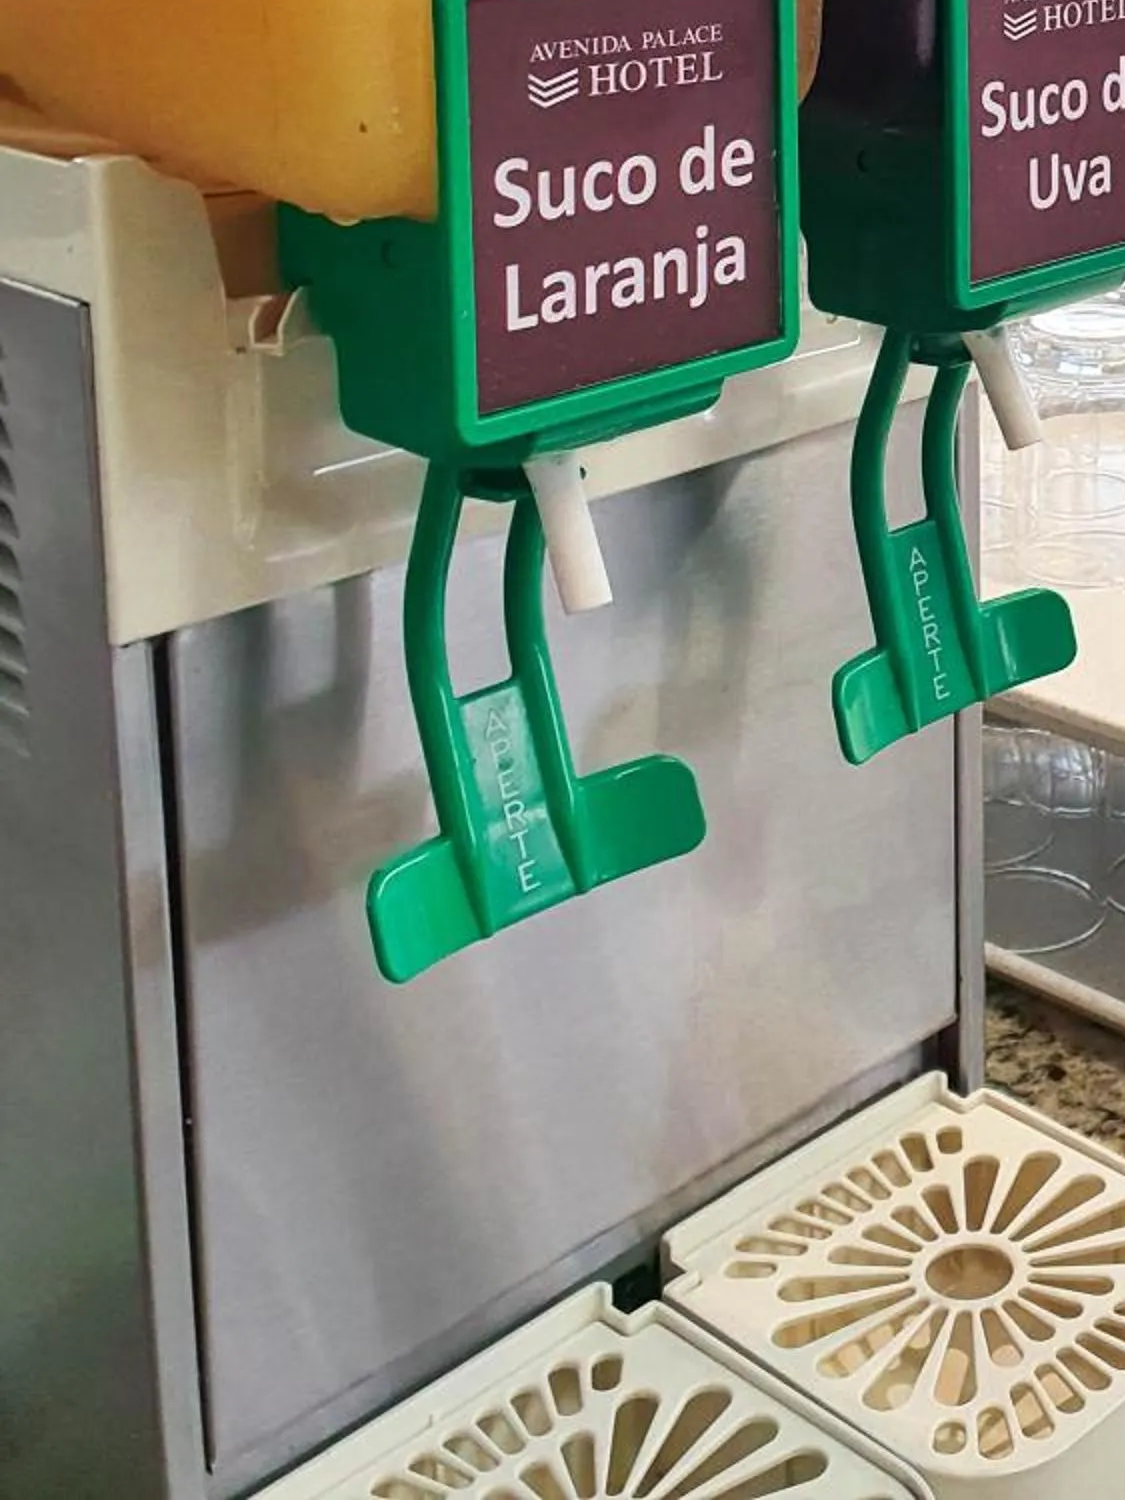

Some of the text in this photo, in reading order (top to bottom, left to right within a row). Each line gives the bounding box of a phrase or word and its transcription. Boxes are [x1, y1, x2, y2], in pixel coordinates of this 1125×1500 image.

[530, 23, 723, 63] AVENIDA PALACE
[588, 51, 723, 97] HOTEL
[980, 78, 1088, 138] Suco
[493, 124, 755, 228] Suco de
[1028, 152, 1112, 210] Uva
[505, 224, 747, 332] Laranja
[909, 547, 950, 701] APERTE
[484, 707, 542, 893] APERTE
